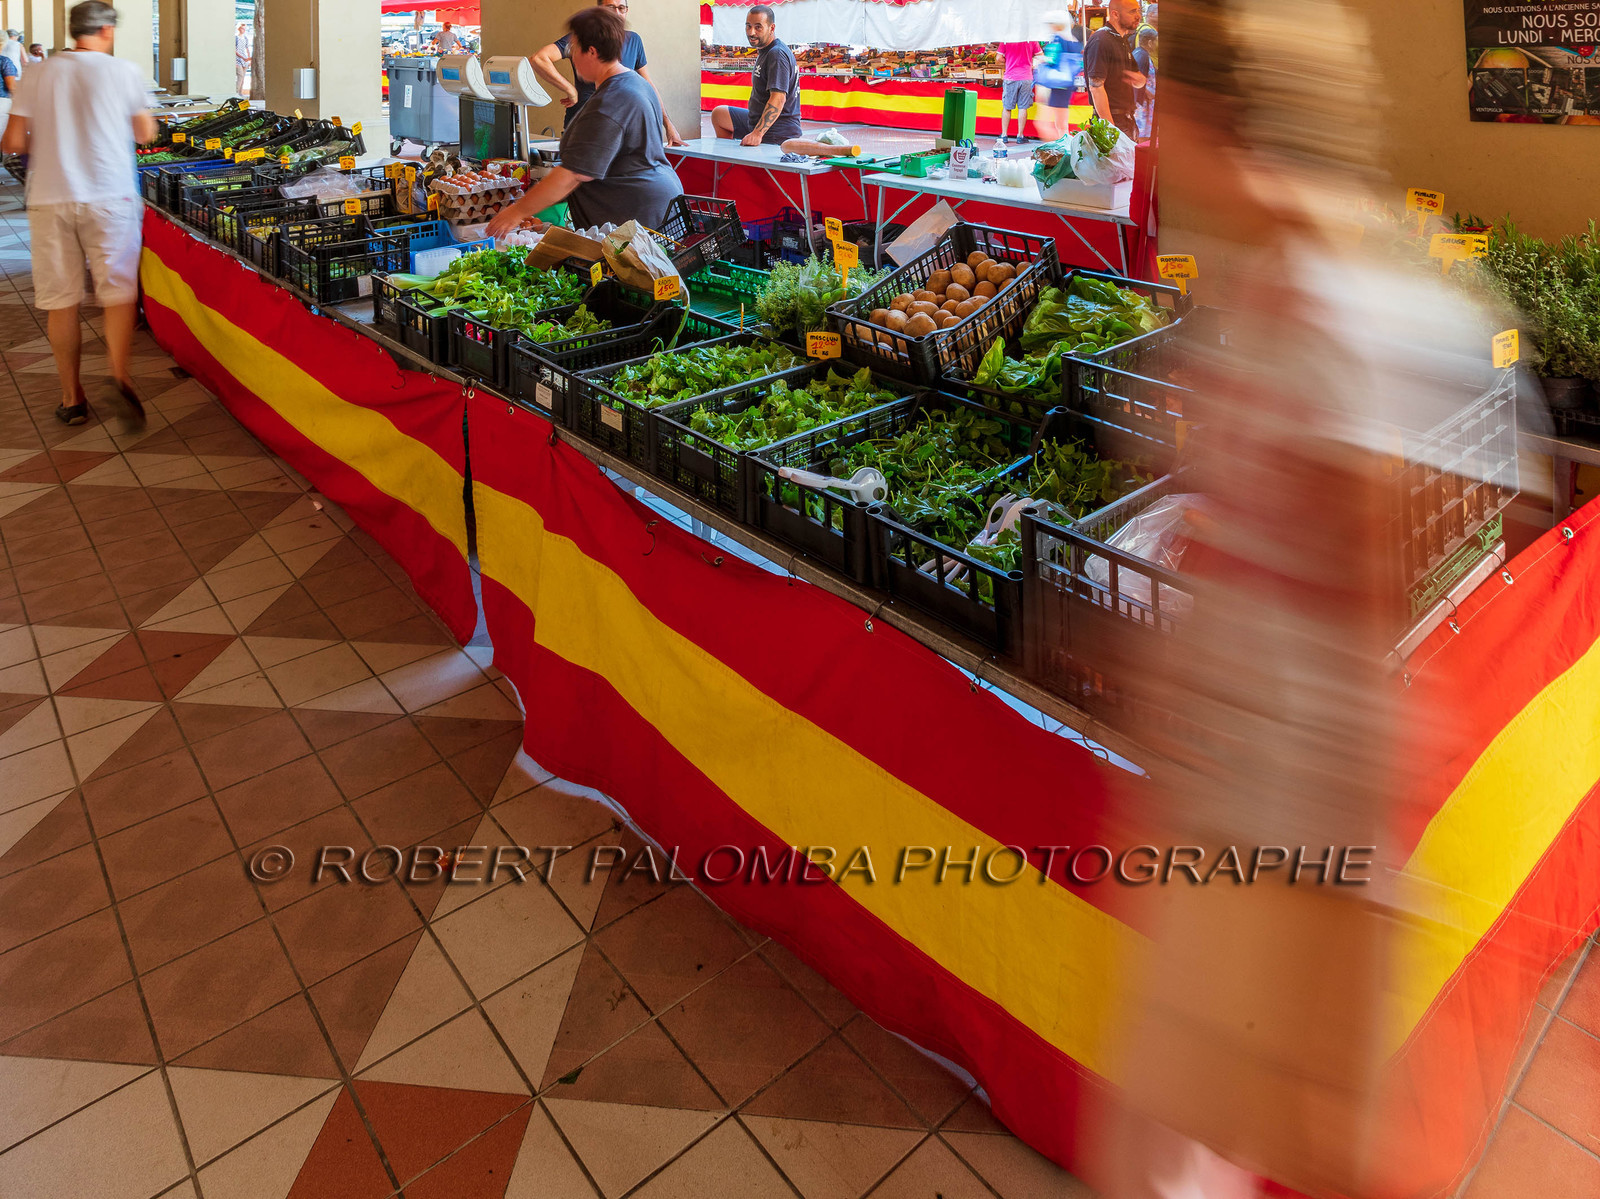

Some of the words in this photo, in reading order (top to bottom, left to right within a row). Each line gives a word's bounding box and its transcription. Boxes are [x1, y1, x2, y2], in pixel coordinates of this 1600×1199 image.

[1504, 5, 1541, 13] CULTIVONS
[1549, 3, 1590, 12] L'ANCIENNE
[1522, 13, 1568, 29] NOUS
[1573, 12, 1600, 28] SO
[1498, 29, 1543, 44] LUNDI
[1567, 55, 1591, 65] NOS
[1440, 237, 1467, 246] SAUGE
